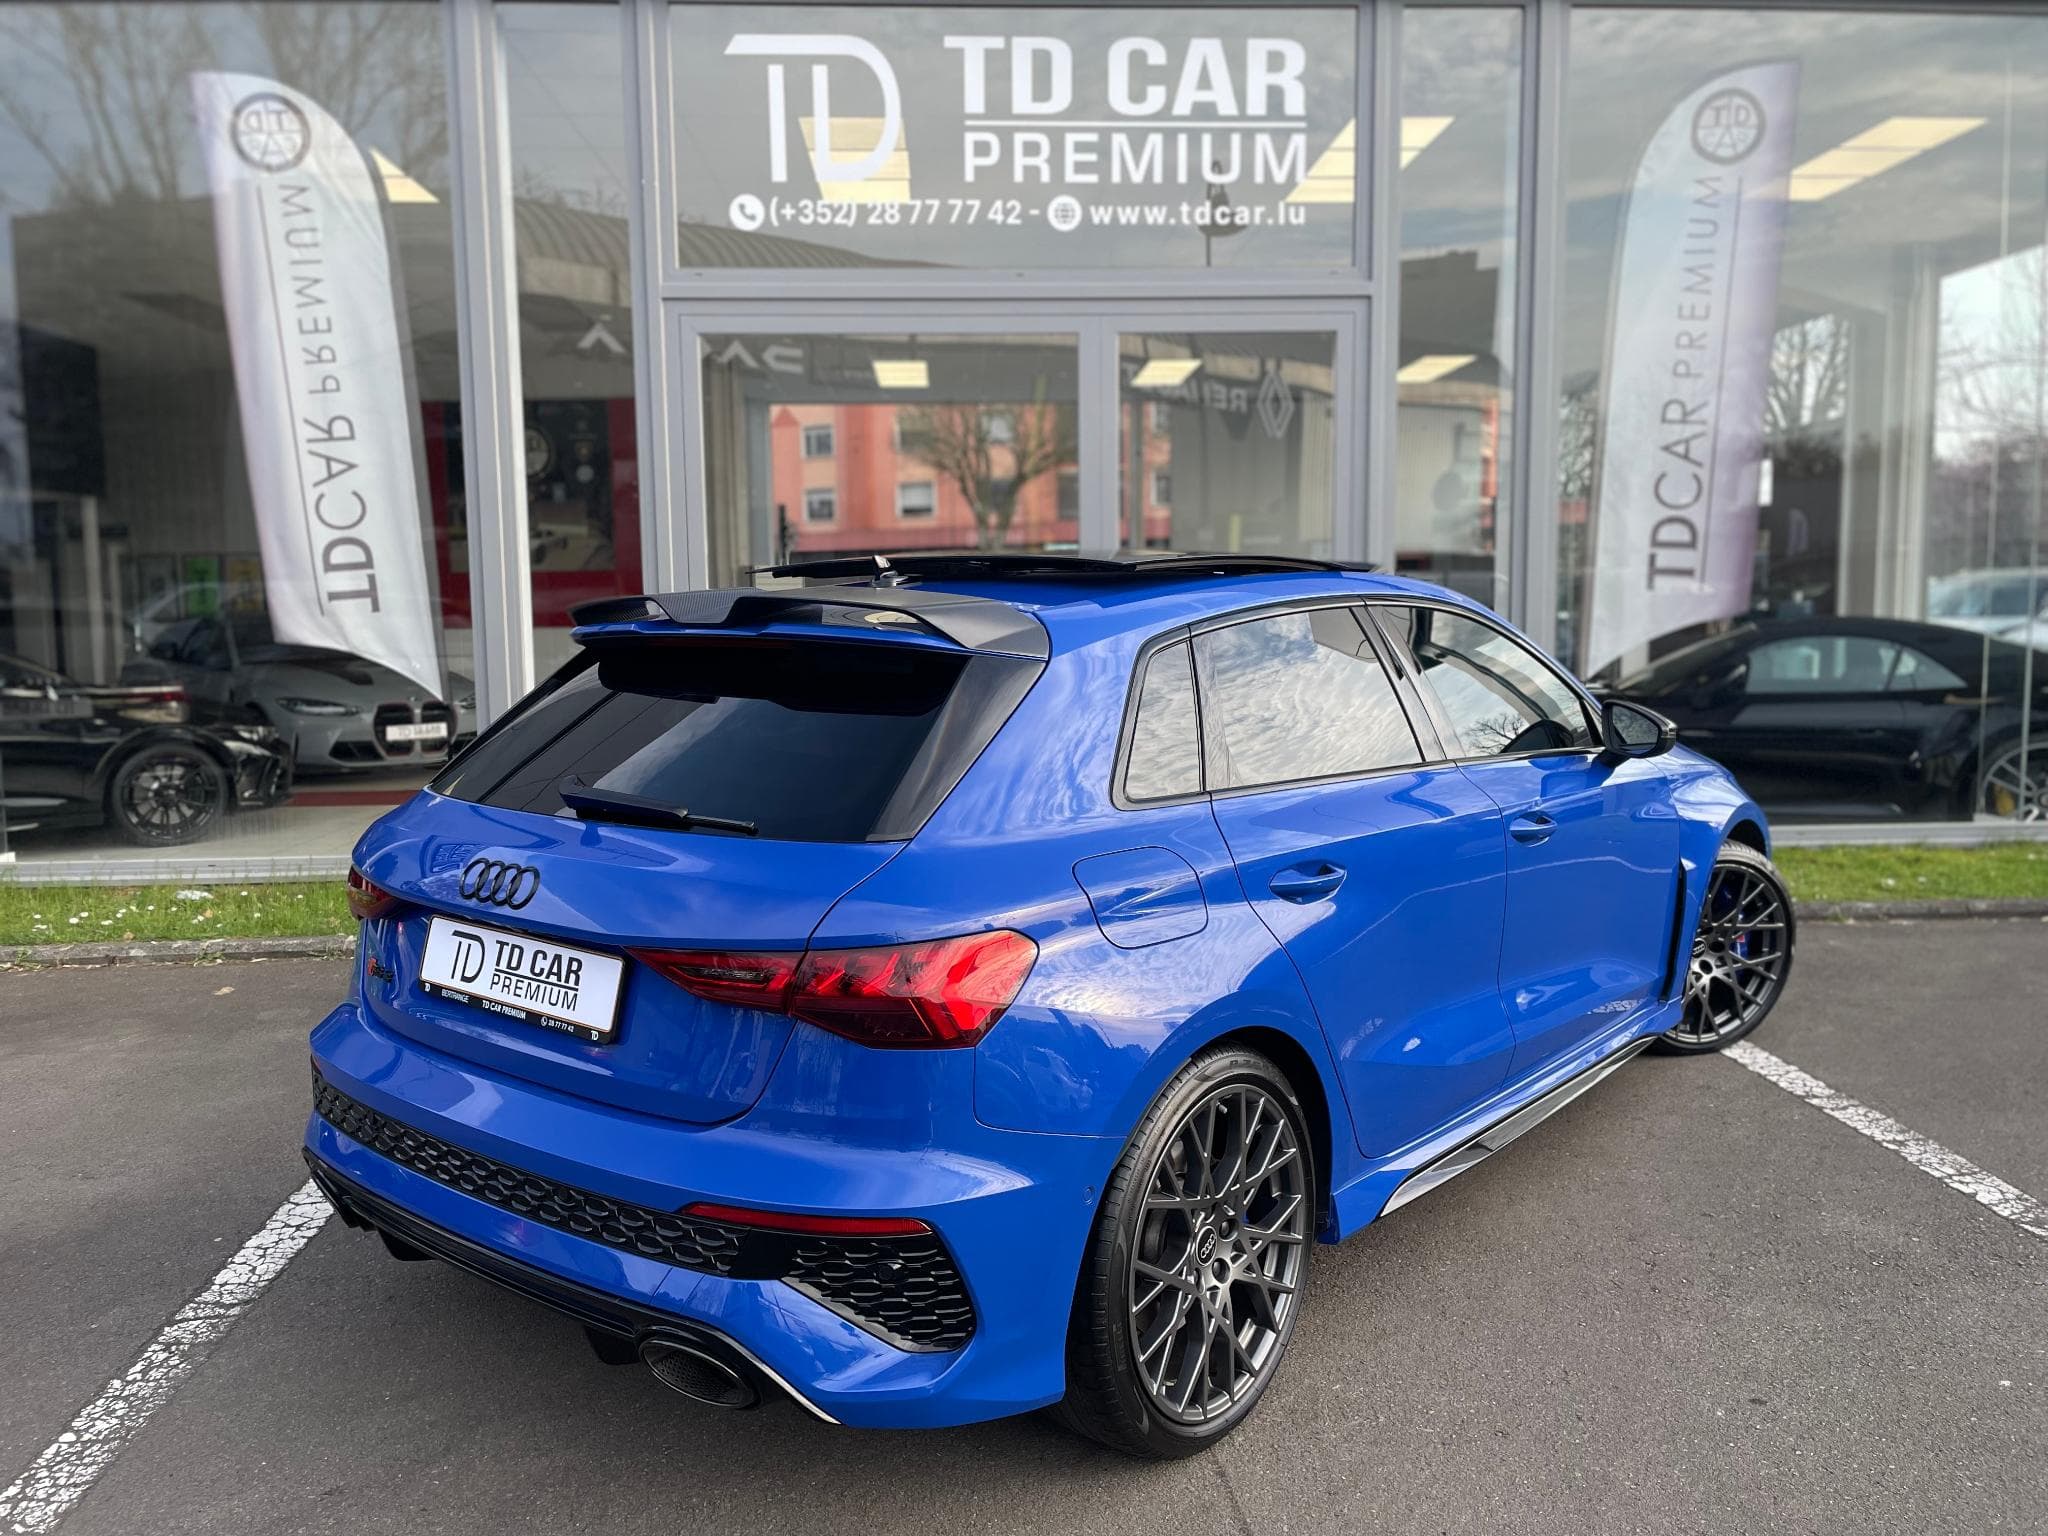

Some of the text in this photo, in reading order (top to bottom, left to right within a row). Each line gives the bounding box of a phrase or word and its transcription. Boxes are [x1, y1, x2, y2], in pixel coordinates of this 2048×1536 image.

[944, 36, 1307, 117] TD CAR
[1709, 104, 1751, 127] TD
[964, 132, 1307, 184] PREMIUM
[769, 197, 857, 227] (+352)
[867, 200, 901, 225] 28
[908, 200, 940, 225] 77
[949, 200, 980, 225] 77
[987, 200, 1022, 225] 42
[1089, 201, 1306, 225] www.tdcar.lu
[1646, 176, 1722, 592] TDCAR PREMIUM
[495, 940, 583, 986] TD CAR
[482, 1000, 526, 1019] TD CAR PREMIUM
[490, 973, 578, 1011] PREMIUM
